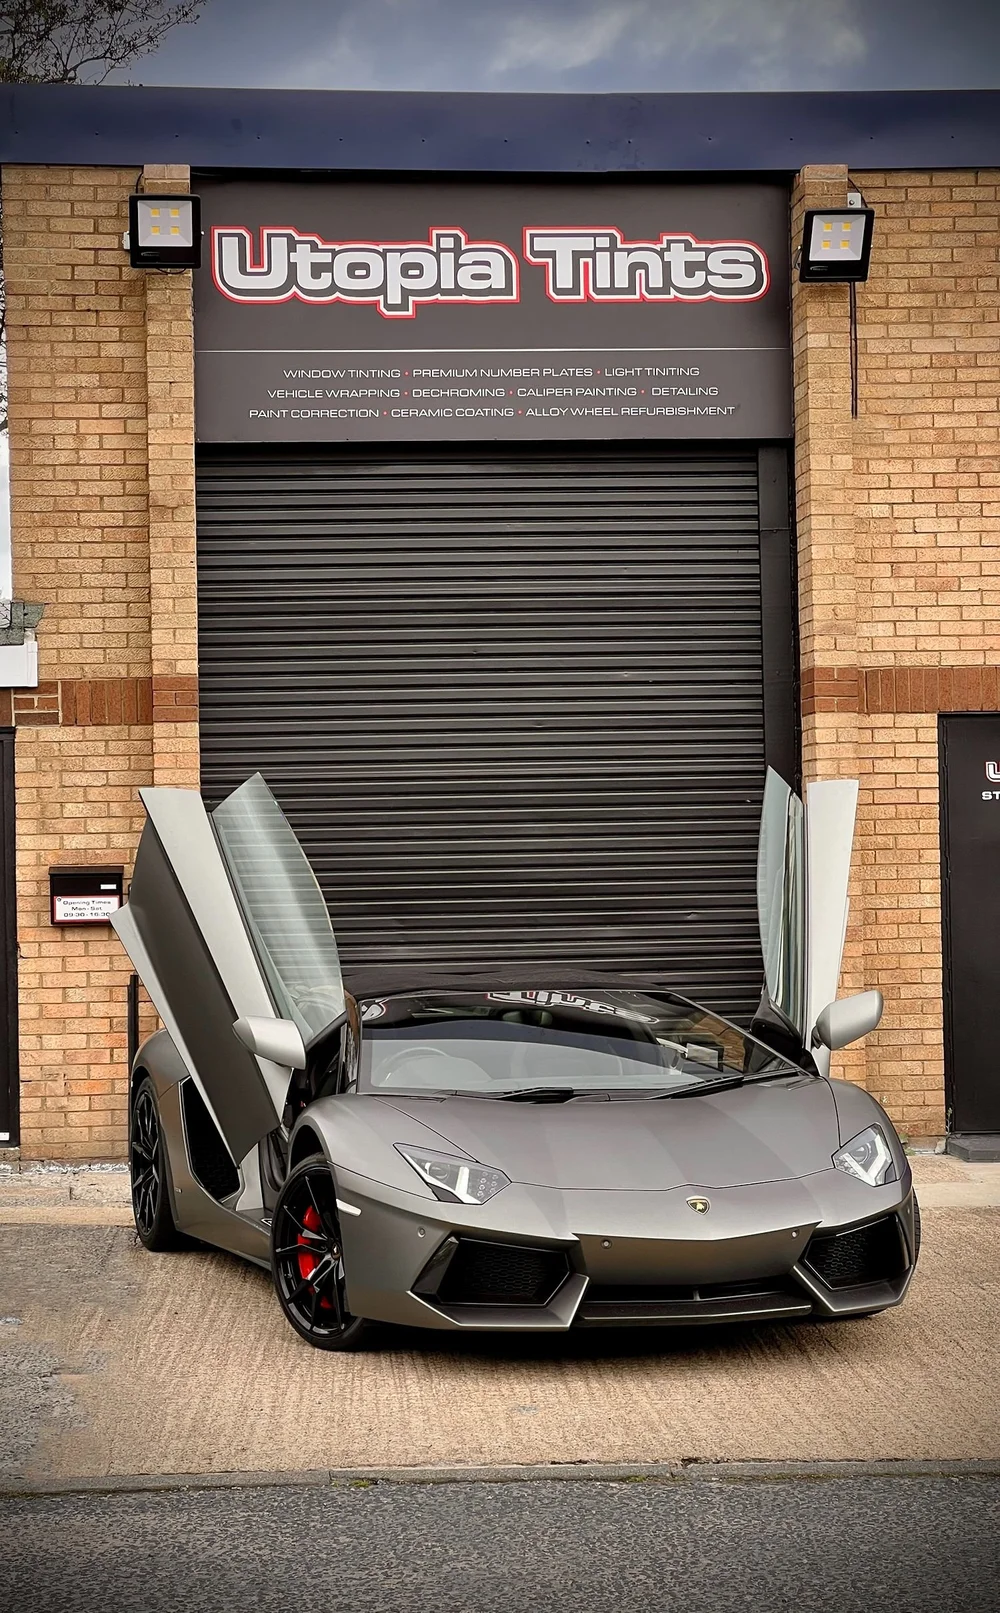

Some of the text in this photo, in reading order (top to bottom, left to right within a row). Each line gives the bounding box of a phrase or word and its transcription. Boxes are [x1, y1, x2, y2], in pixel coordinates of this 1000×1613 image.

[216, 232, 764, 309] Utopia Tints
[283, 367, 700, 379] WINDOW TINTING PREMIUM NUMBER PLATES LIGHT TINITING
[267, 387, 719, 399] VEHICLE WRAPPING DECHROMING CALIPER PAINTING DETAILING
[249, 406, 736, 419] PAINT CORRECTION CERAMIC COATING ALLOY WHEEL REFURBISHMENT
